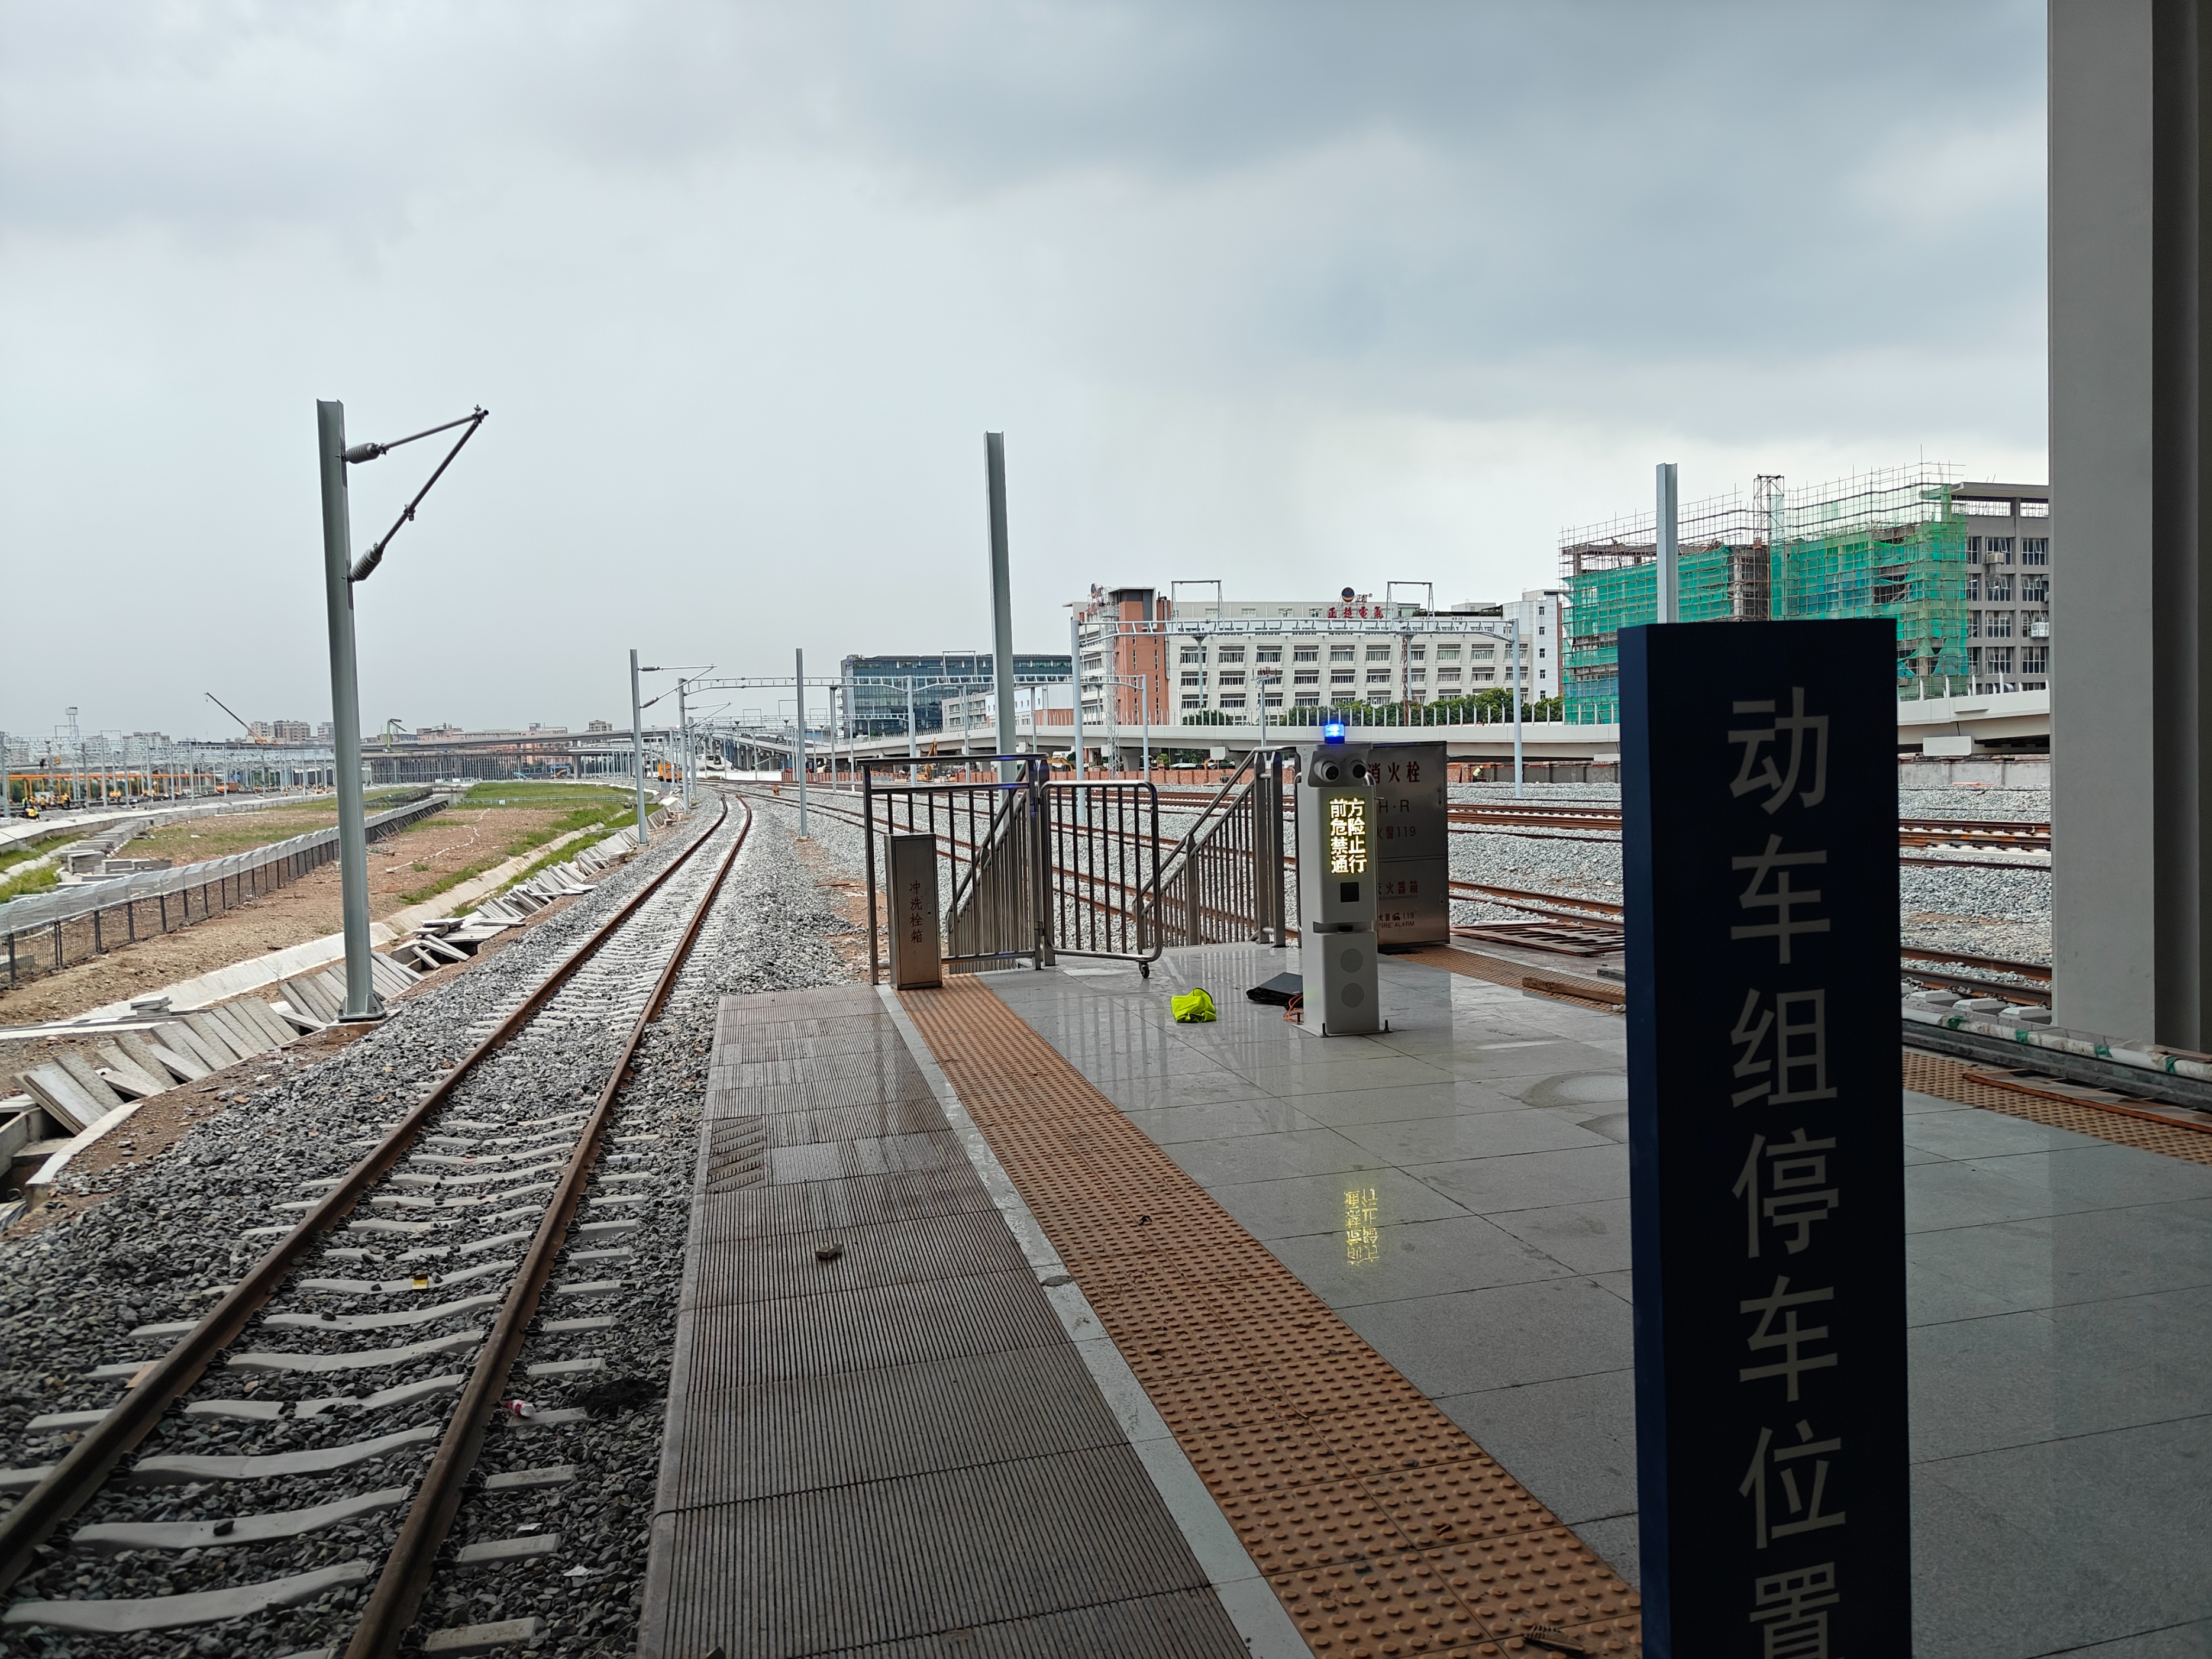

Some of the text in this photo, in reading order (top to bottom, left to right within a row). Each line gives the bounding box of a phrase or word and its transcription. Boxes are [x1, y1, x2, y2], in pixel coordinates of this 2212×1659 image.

[1368, 761, 1420, 784] 消火栓
[1330, 798, 1365, 818] 前方
[1330, 817, 1365, 836] 危险
[1331, 835, 1365, 855] 禁止
[1331, 854, 1367, 873] 通行
[909, 880, 923, 944] 冲洗栓箱
[1728, 686, 1846, 1659] 动车组停车位置
